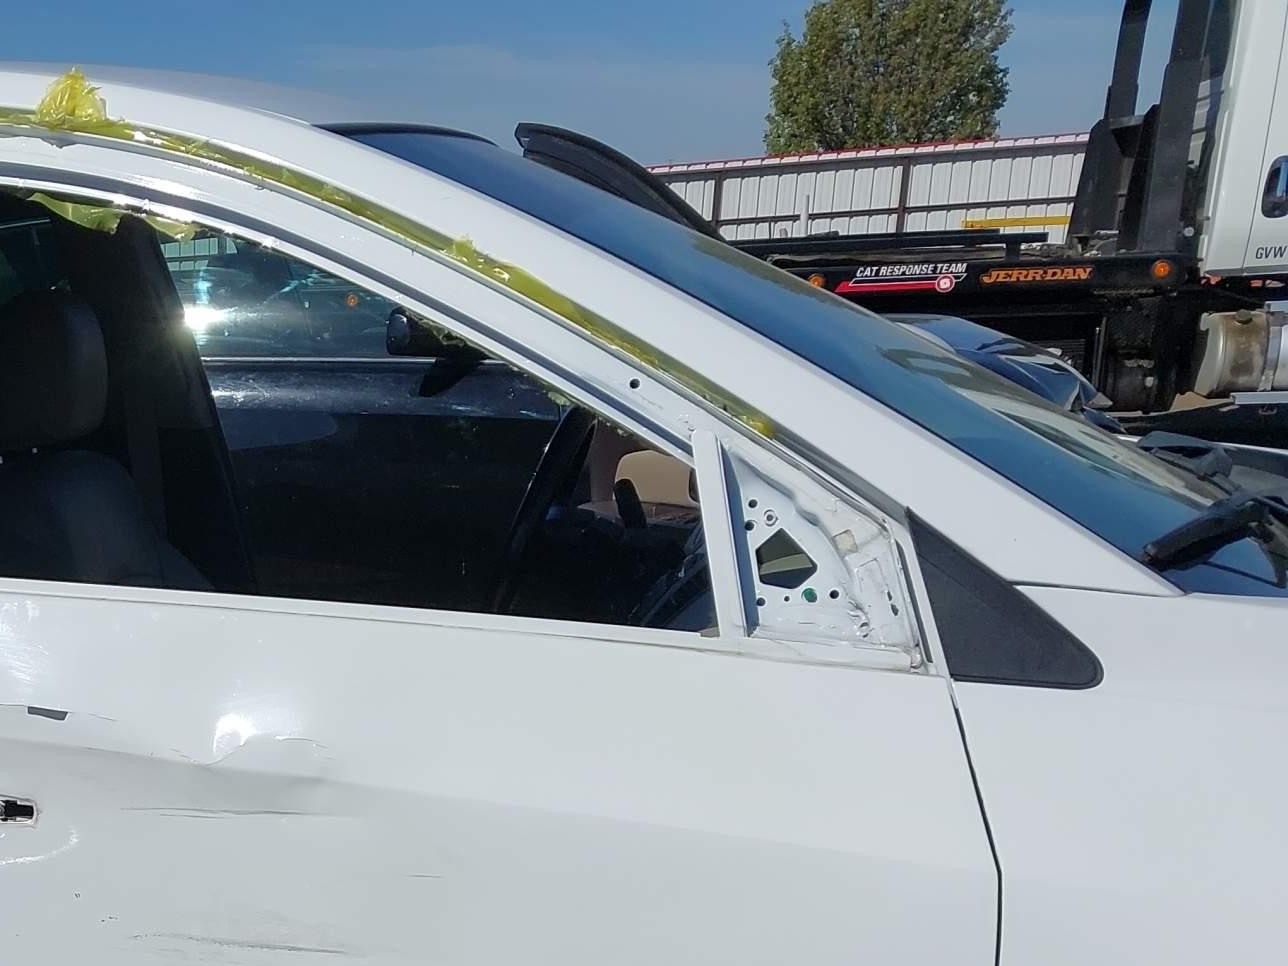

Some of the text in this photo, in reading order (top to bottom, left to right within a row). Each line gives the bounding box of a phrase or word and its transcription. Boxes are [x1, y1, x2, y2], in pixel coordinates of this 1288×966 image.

[856, 262, 968, 278] CAT RESPONSE TEAM
